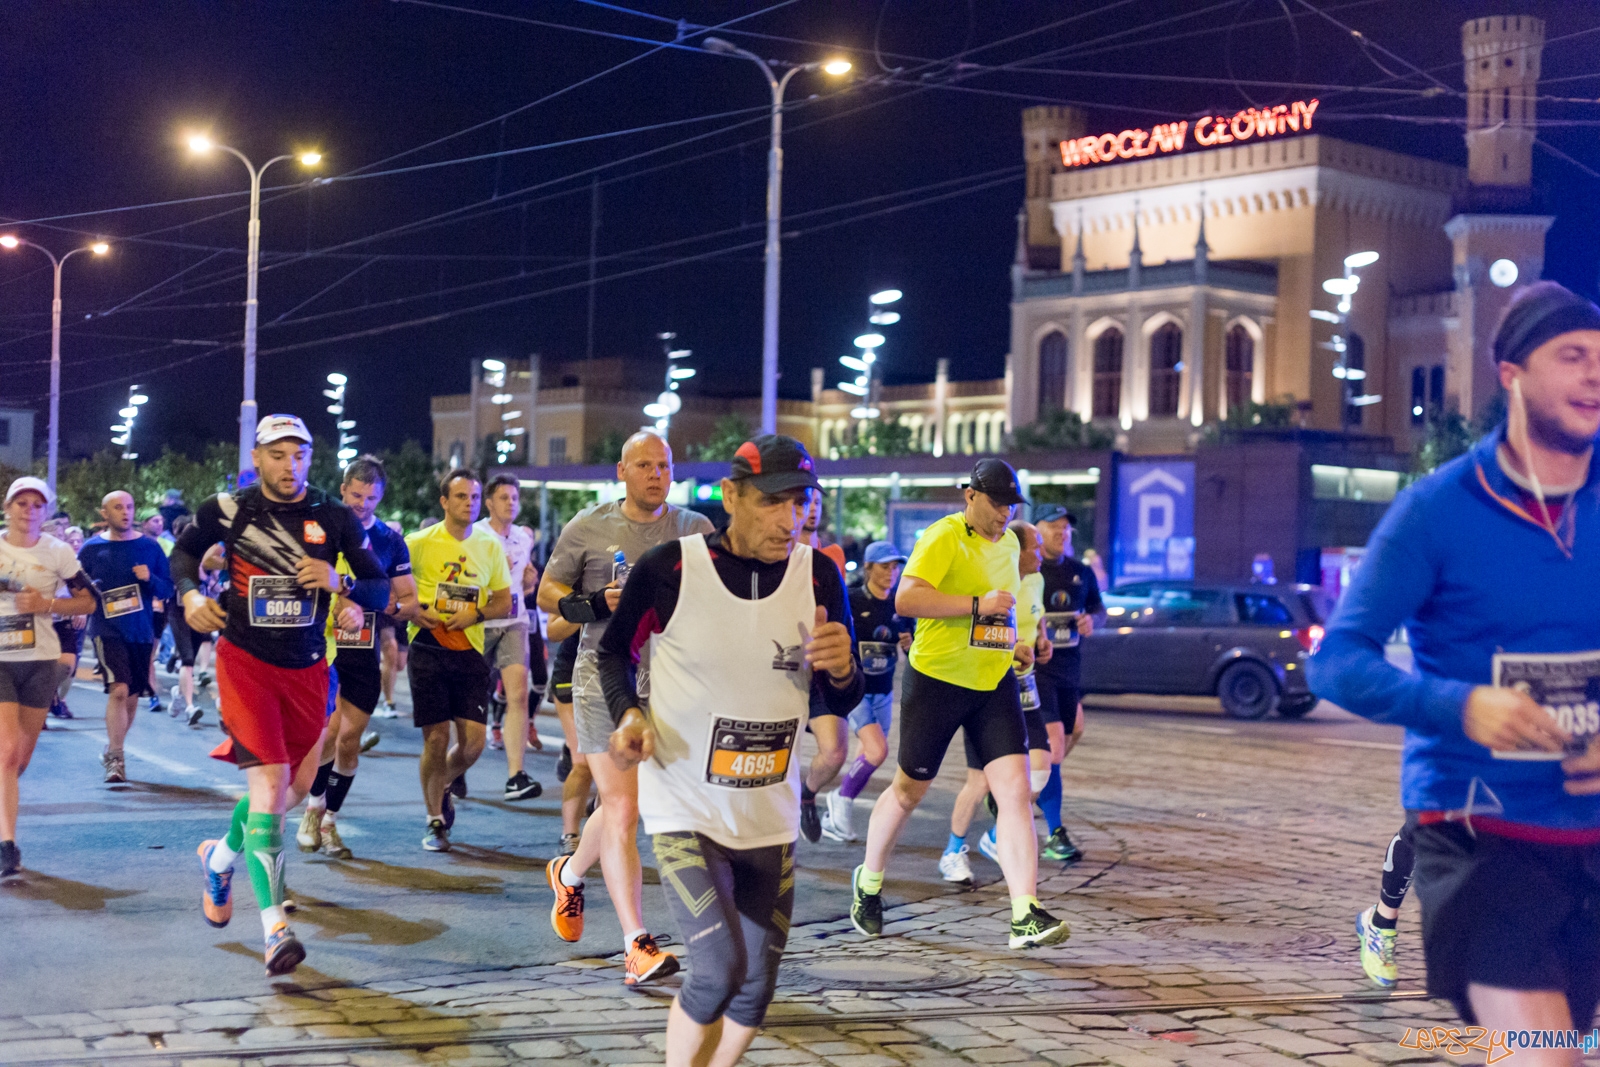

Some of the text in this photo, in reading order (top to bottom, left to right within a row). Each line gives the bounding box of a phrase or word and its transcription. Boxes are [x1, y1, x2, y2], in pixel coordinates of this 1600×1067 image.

[266, 600, 302, 616] 6049
[983, 626, 1009, 641] 2944
[730, 753, 776, 776] 4695
